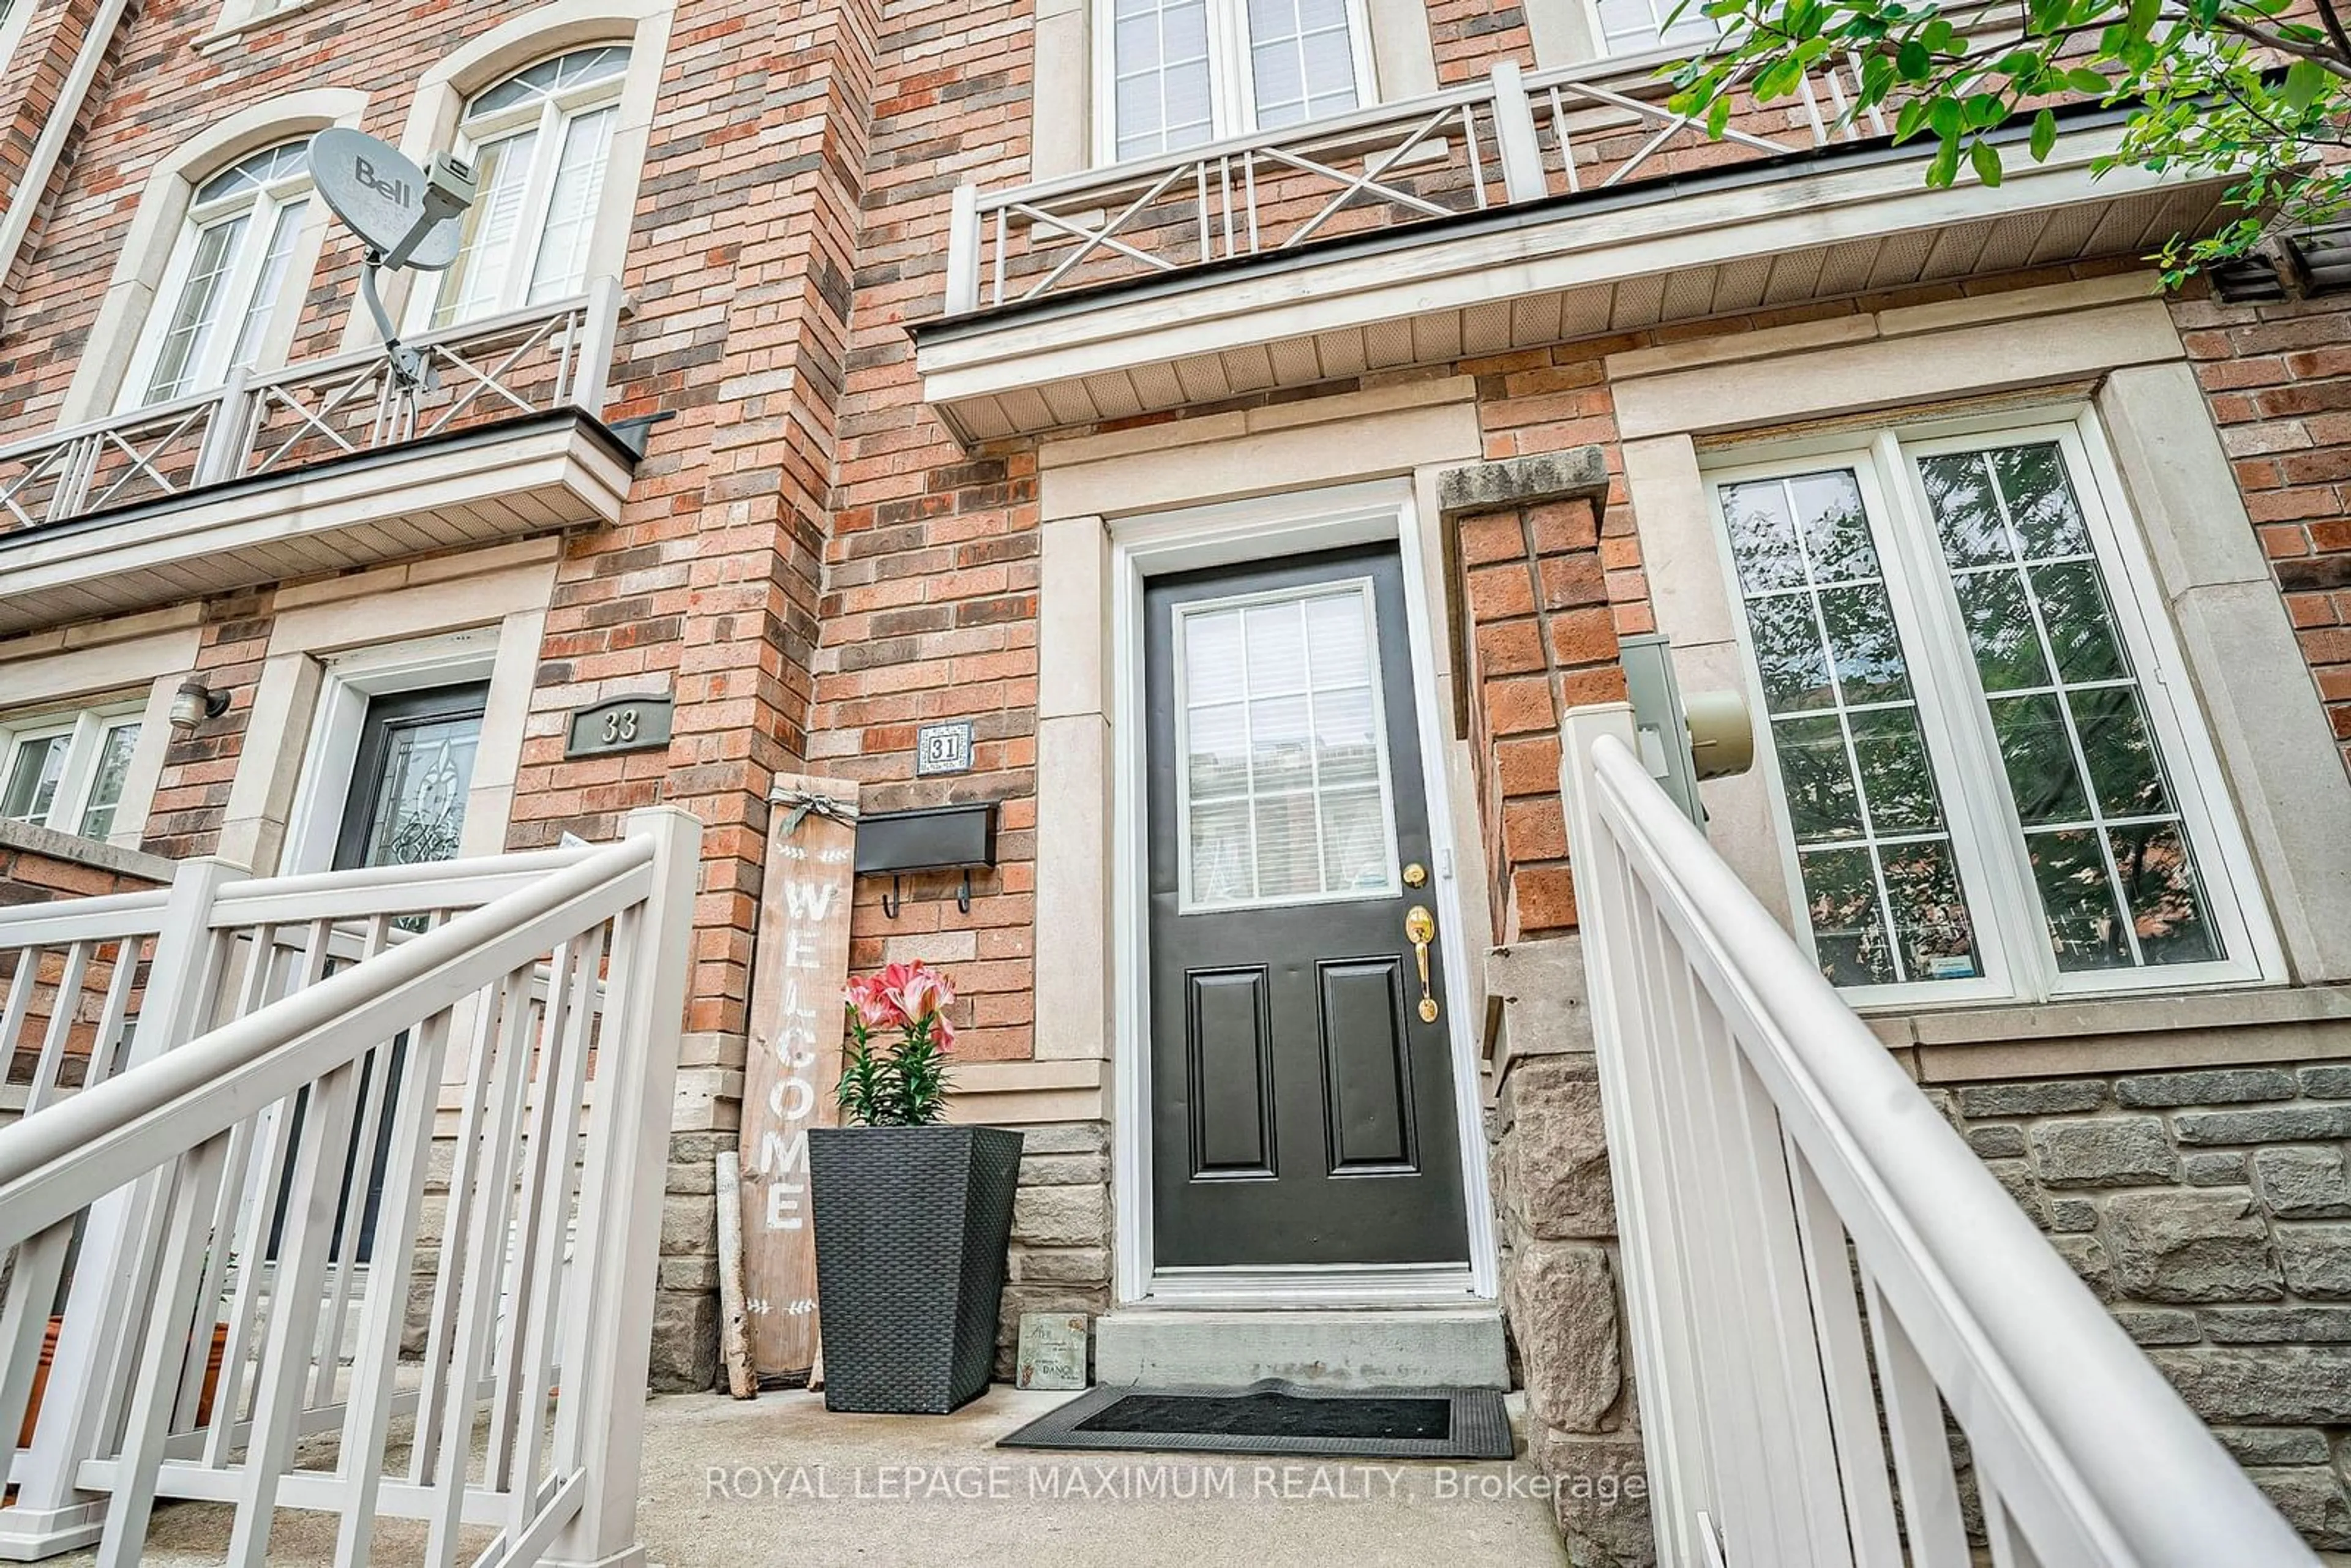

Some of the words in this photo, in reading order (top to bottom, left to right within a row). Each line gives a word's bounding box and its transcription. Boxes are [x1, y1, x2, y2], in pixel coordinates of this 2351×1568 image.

[356, 156, 410, 208] Bell
[602, 710, 637, 742] 33
[932, 738, 955, 759] 31
[760, 880, 836, 1229] WELCOME
